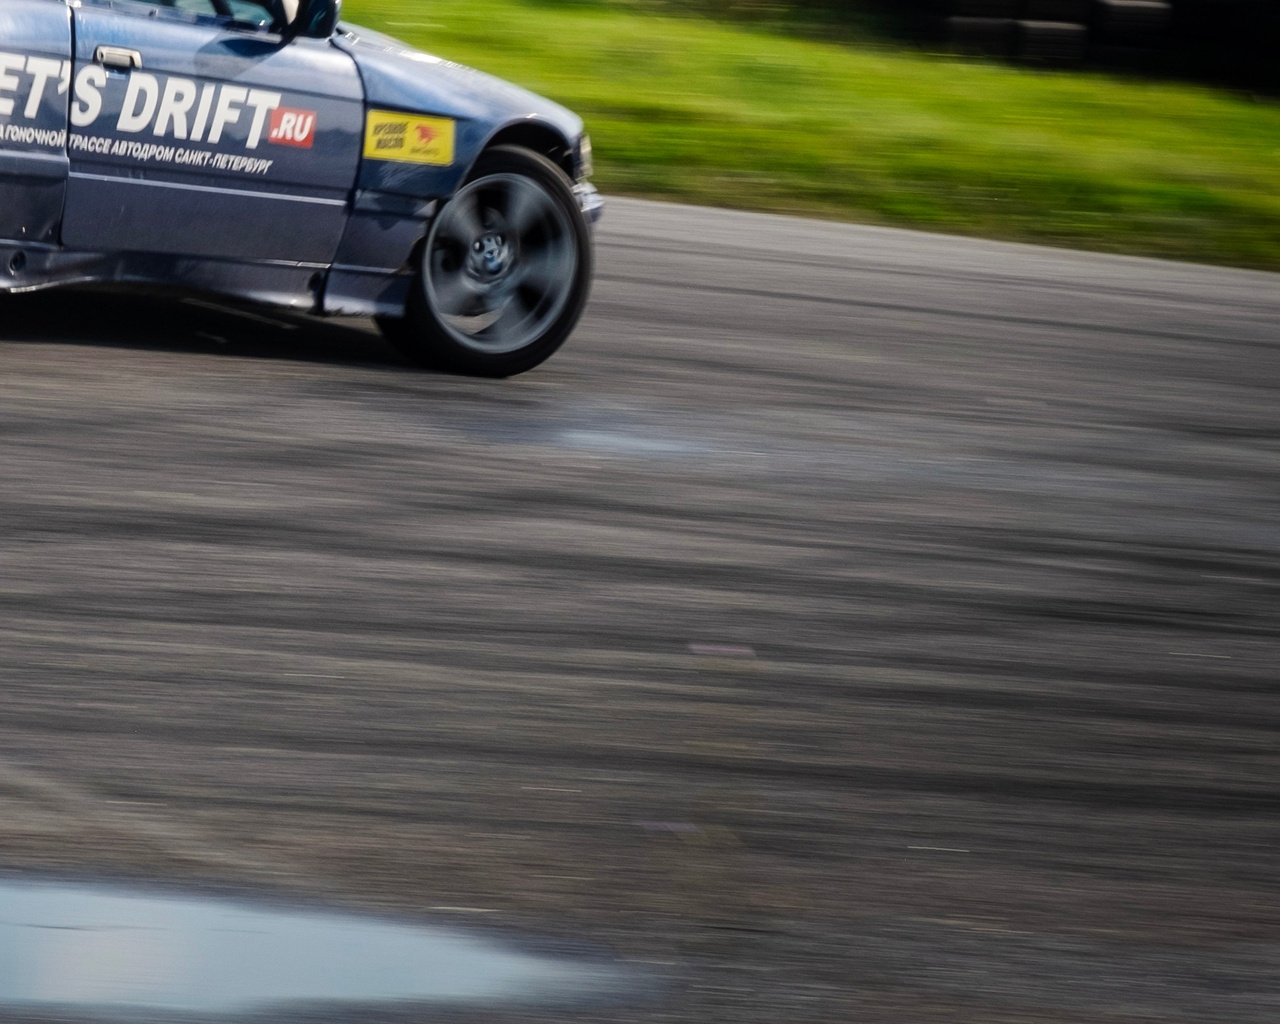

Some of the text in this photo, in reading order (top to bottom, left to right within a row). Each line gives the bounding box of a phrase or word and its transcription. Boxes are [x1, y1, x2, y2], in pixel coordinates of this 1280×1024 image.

[5, 125, 67, 148] ГОНОЧНОЙ
[70, 133, 112, 154] ТРАССЕ
[111, 139, 175, 162] АВТОДРОМ
[175, 147, 273, 175] САНКТ-ПЕТЕРБУРГ
